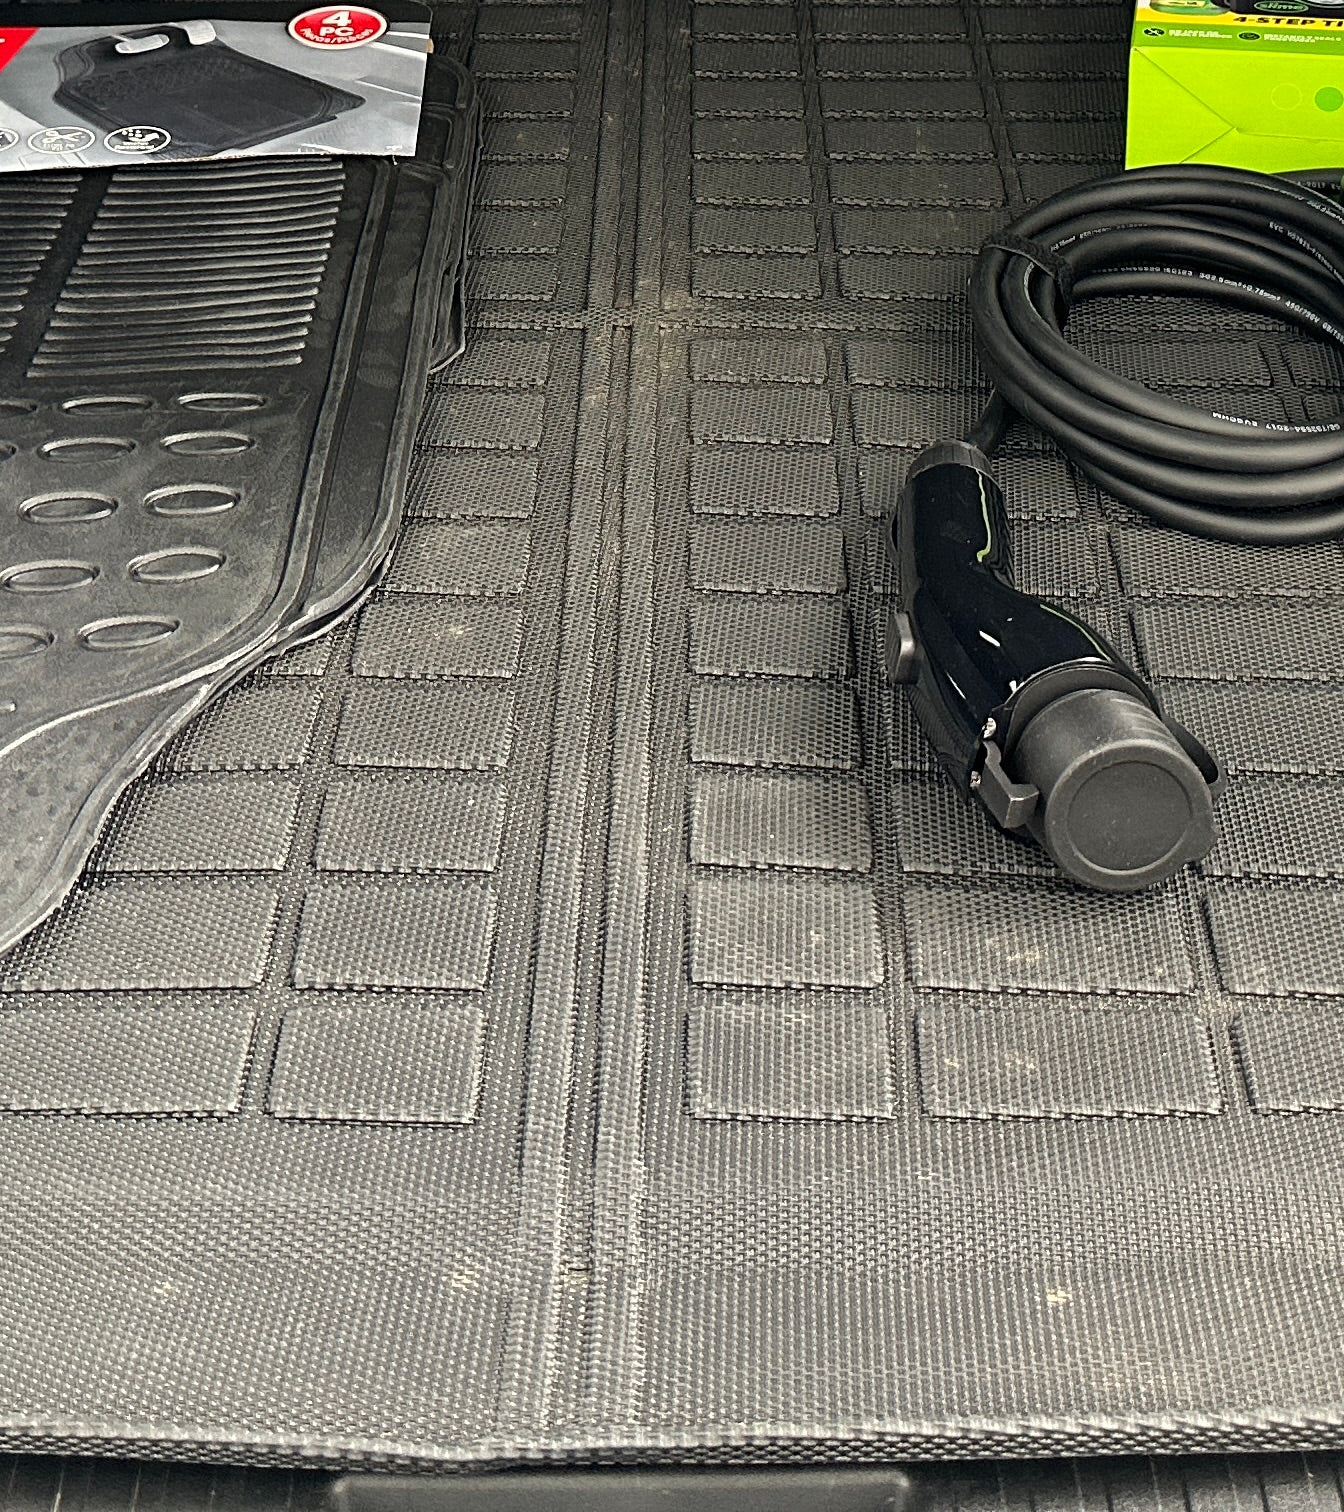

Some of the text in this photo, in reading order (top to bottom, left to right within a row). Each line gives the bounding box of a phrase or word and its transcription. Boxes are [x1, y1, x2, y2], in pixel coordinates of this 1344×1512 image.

[321, 11, 352, 27] 4
[1233, 17, 1316, 27] 4-STEP
[319, 26, 354, 37] PC
